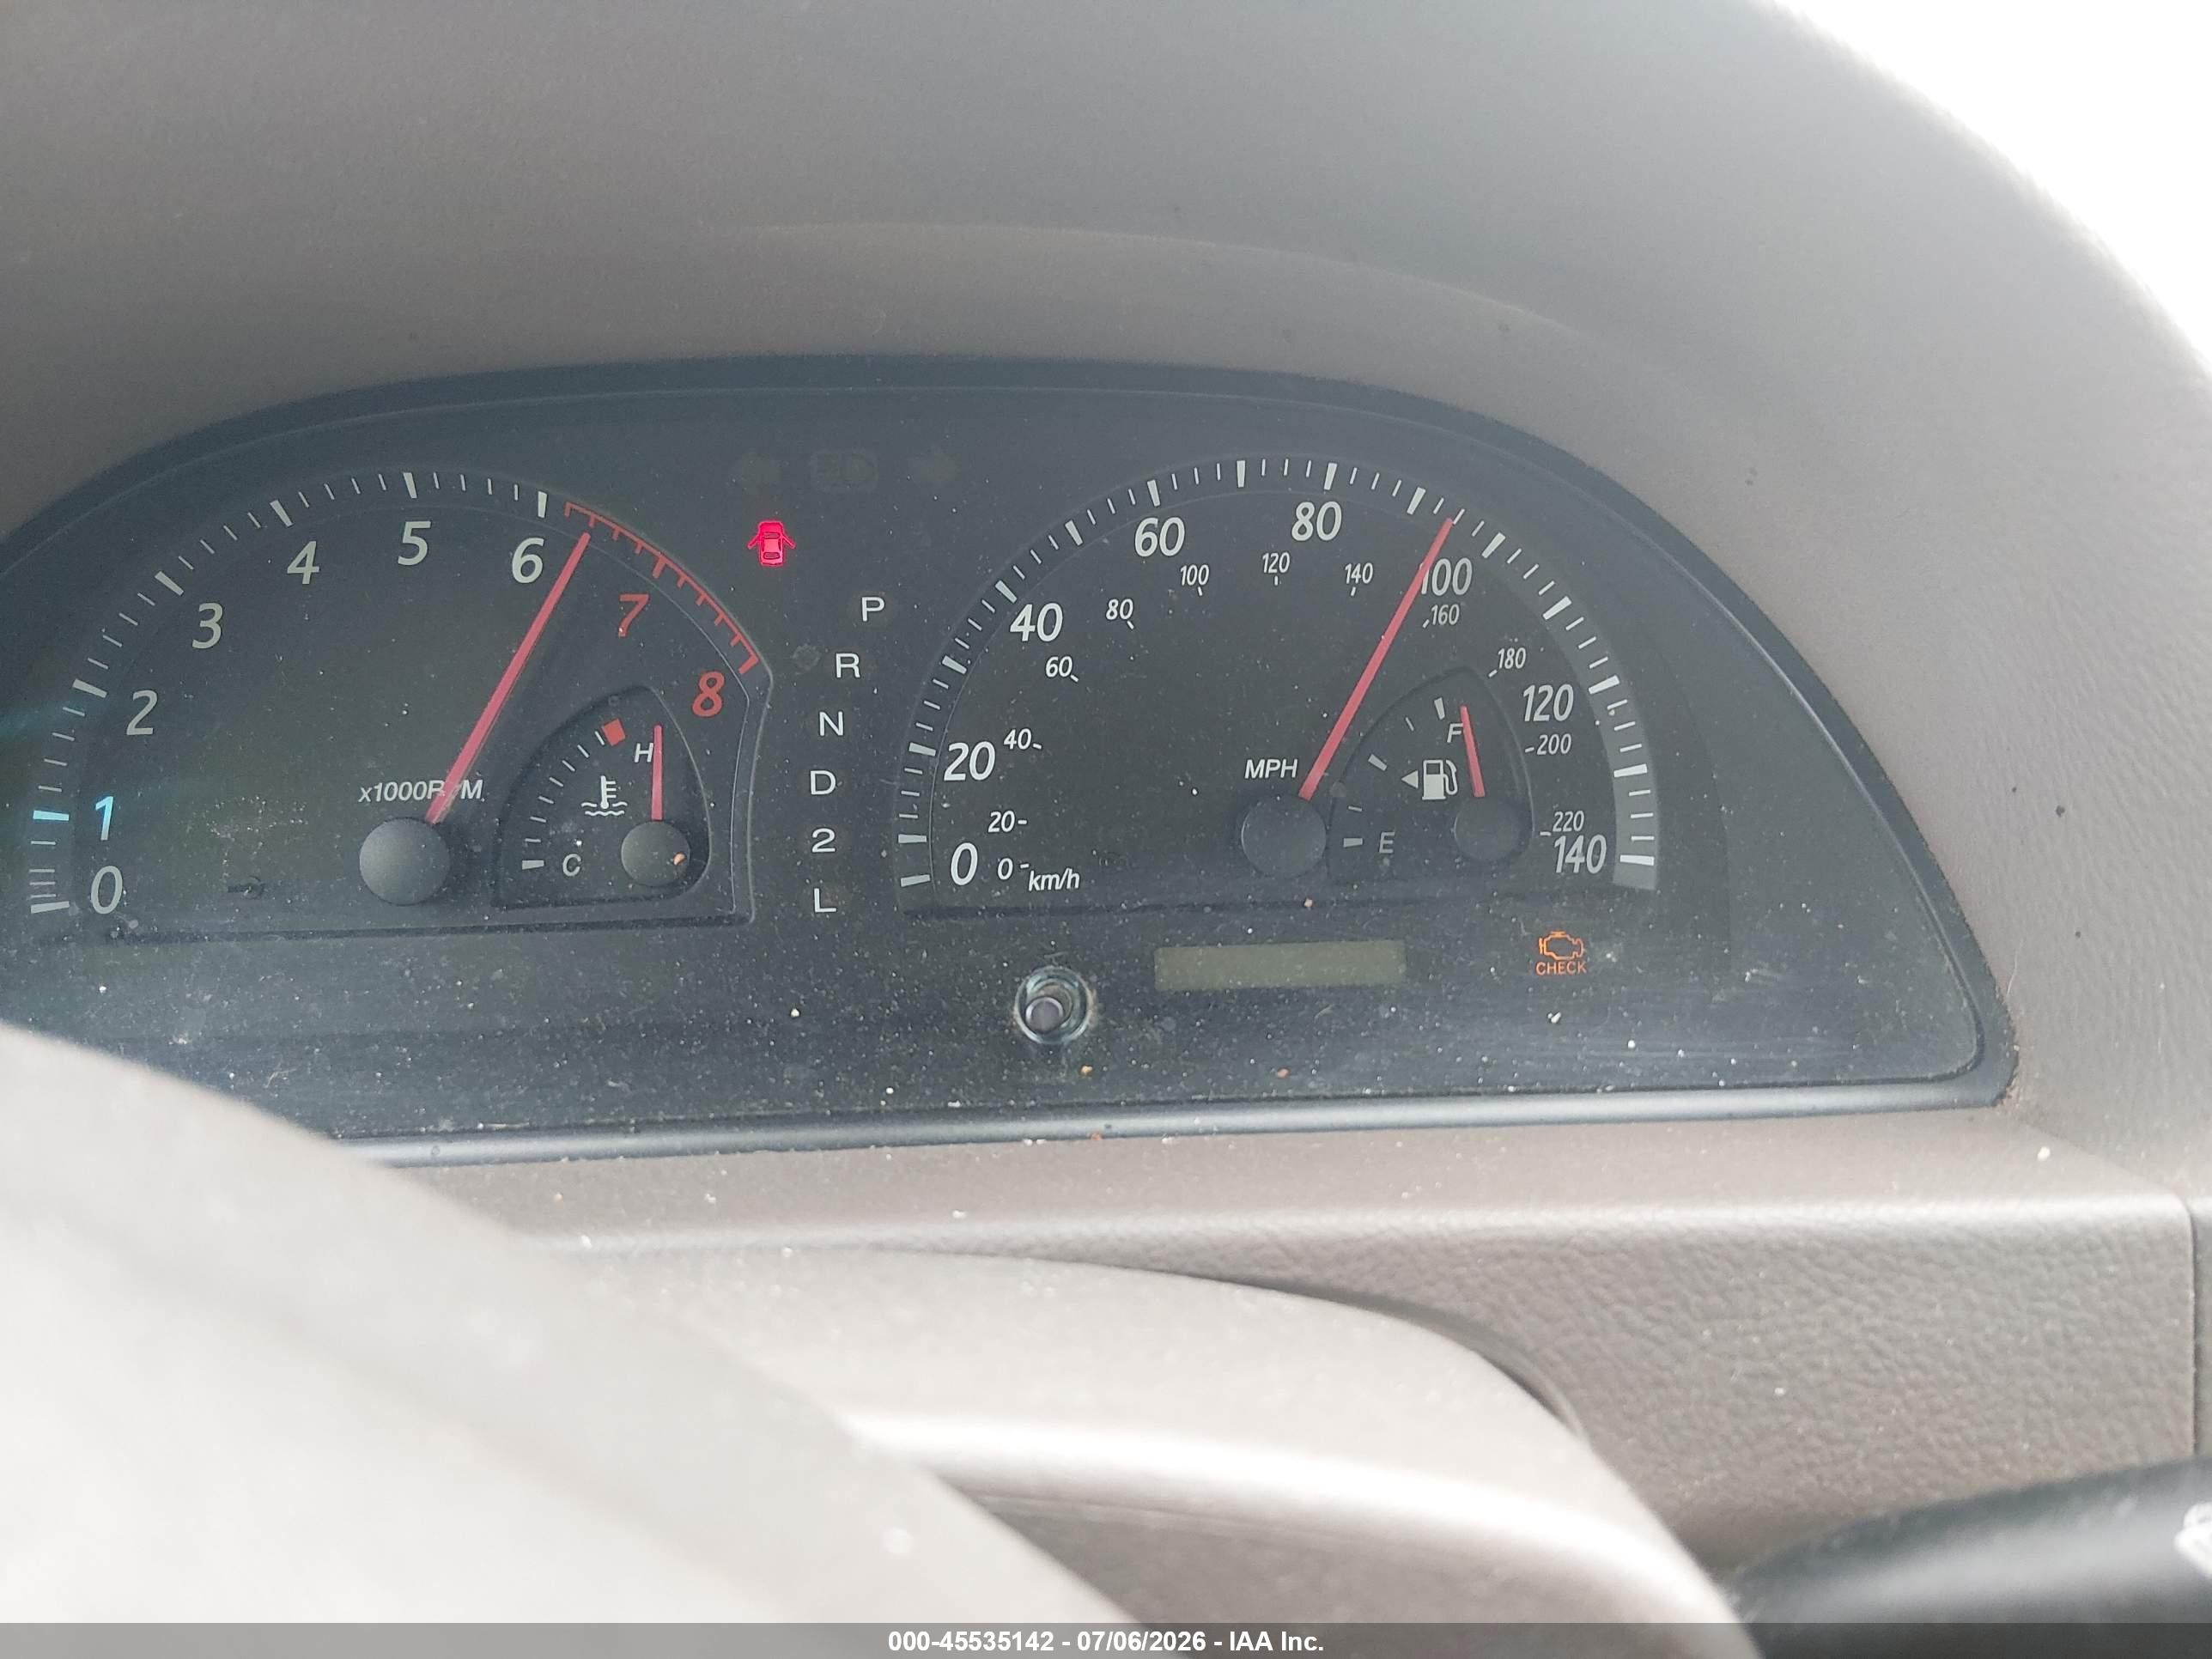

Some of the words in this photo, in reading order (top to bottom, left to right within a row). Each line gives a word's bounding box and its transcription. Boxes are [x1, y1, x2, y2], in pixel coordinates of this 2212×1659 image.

[1291, 501, 1341, 540] 80
[398, 520, 431, 566] 5
[1134, 517, 1185, 556] 60
[287, 541, 319, 584] 4
[511, 538, 544, 584] 6
[1262, 552, 1290, 574] 120
[1345, 562, 1373, 584] 140
[1180, 564, 1210, 586] 100
[618, 593, 649, 637] 7
[861, 597, 885, 622] P
[1010, 602, 1063, 642] 40
[1106, 599, 1133, 620] 80
[1431, 603, 1460, 625] 160
[191, 603, 223, 648] 3
[836, 653, 860, 678] R
[1045, 657, 1073, 678] 60
[1497, 648, 1526, 669] 180
[692, 671, 725, 717] 8
[1522, 684, 1574, 722] 120
[126, 690, 159, 735] 2
[818, 712, 844, 737] N
[1004, 728, 1032, 750] 40
[1446, 722, 1463, 744] F
[1536, 735, 1571, 756] 200
[634, 743, 653, 763] H
[944, 741, 996, 781] 20
[1244, 759, 1298, 780] MPH
[358, 780, 483, 802] x1000RM
[811, 770, 836, 795] D
[95, 796, 113, 842] 1
[988, 811, 1016, 833] 20
[1553, 811, 1584, 831] 220
[811, 829, 836, 854] 2
[1378, 832, 1395, 854] E
[1553, 835, 1607, 873] 140
[562, 854, 582, 877] C
[950, 842, 978, 885] 0
[997, 858, 1013, 879] 0
[90, 866, 124, 915] 0
[1028, 867, 1081, 891] km/h
[814, 888, 836, 913] L
[1535, 960, 1588, 976] CHECK
